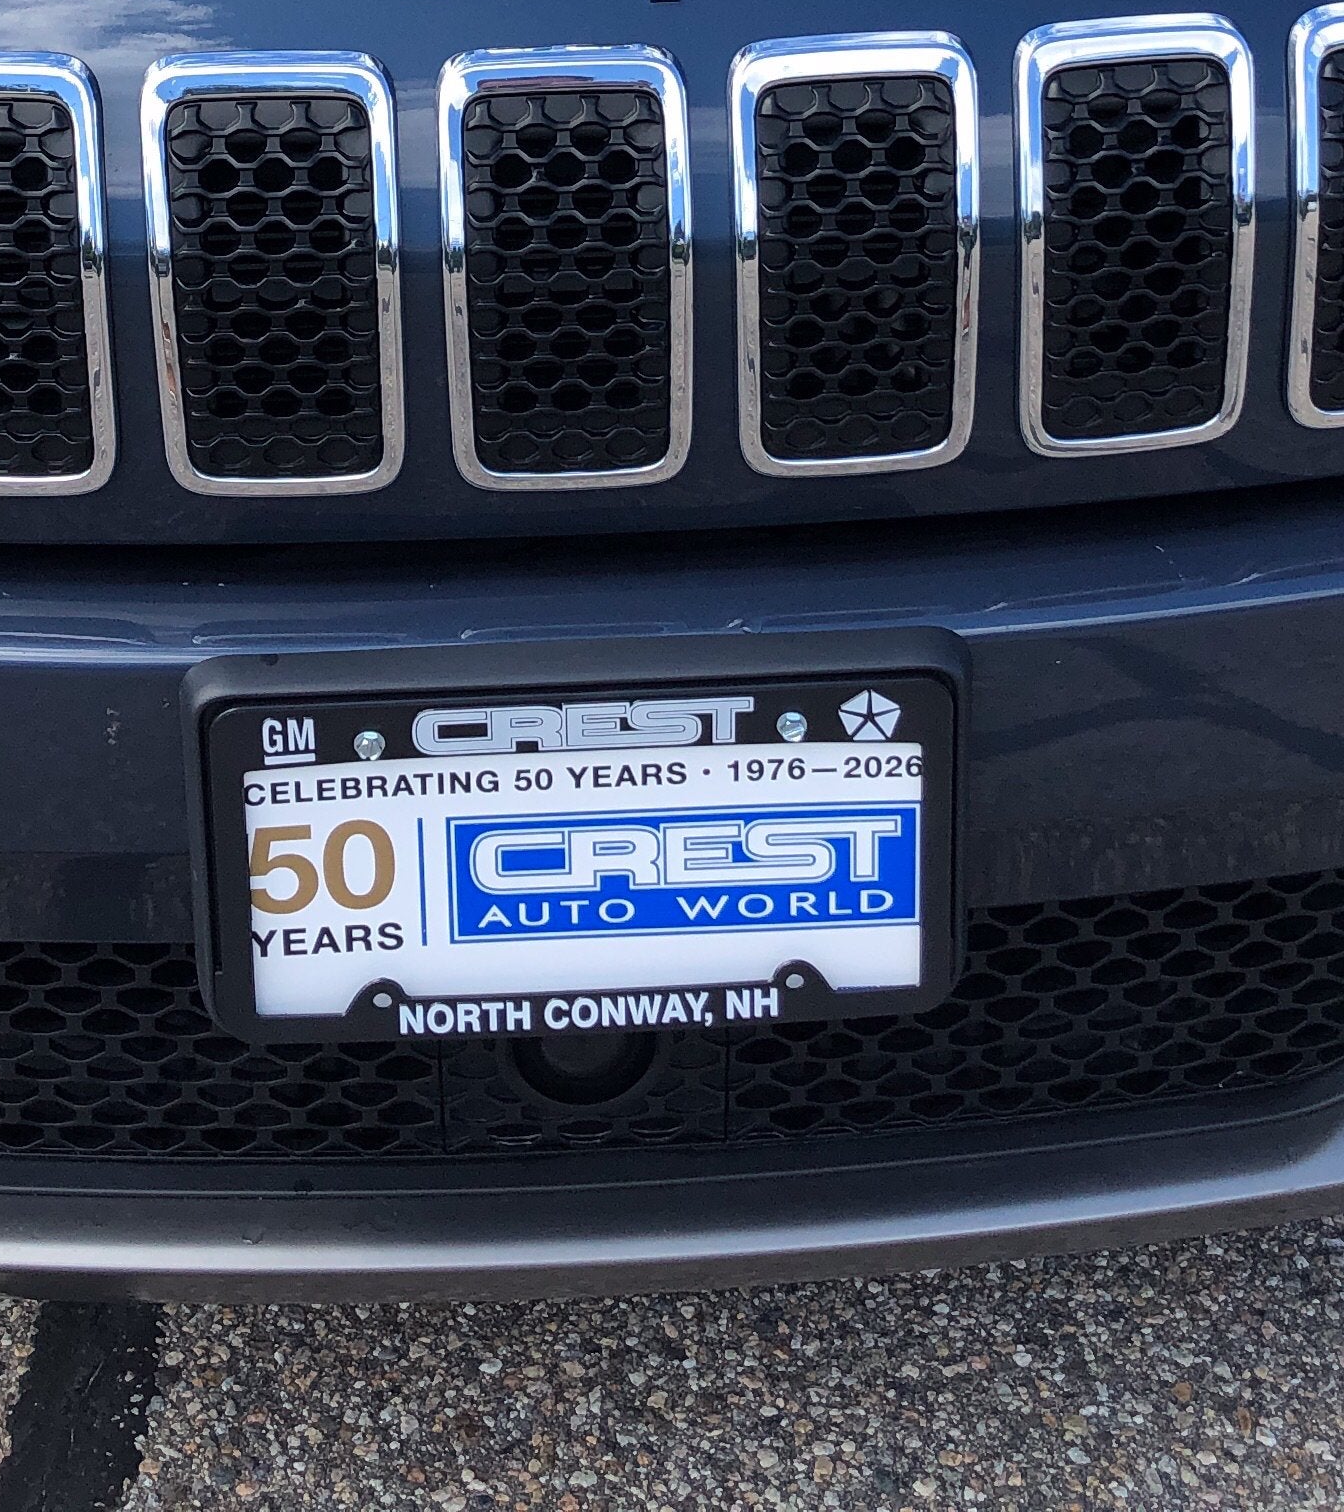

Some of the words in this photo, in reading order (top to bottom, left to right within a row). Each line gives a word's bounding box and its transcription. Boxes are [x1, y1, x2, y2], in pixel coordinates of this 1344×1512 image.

[262, 717, 316, 754] GM
[412, 696, 755, 756] CREST
[244, 770, 499, 807] CELEBRATING
[513, 767, 554, 791] 50
[567, 761, 688, 789] YEARS
[249, 818, 396, 915] 50
[469, 814, 902, 896] CREST
[477, 897, 636, 929] AUTO
[676, 889, 895, 921] WORLD
[251, 922, 405, 958] YEARS
[399, 1001, 532, 1035] NORTH
[544, 991, 713, 1030] CONWAY,
[726, 988, 779, 1020] NH
